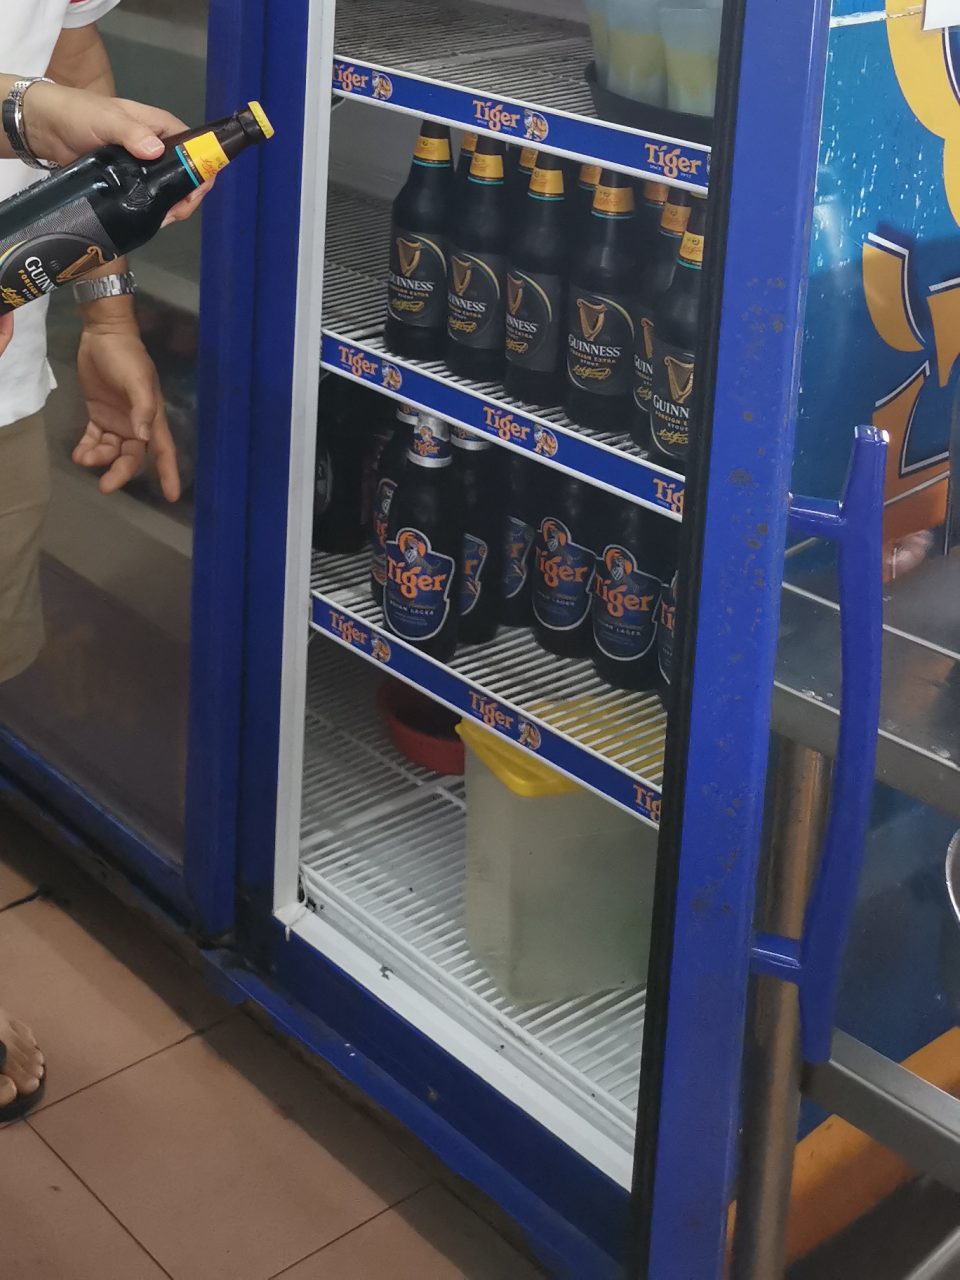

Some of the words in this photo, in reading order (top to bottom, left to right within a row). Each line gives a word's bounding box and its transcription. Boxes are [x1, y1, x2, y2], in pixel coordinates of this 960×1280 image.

[472, 99, 520, 131] Tiger
[644, 142, 701, 178] Tiger
[25, 256, 58, 293] GUINN
[339, 345, 379, 376] Tiger
[568, 333, 622, 358] GUINNESS
[634, 354, 653, 375] GUIN
[483, 406, 530, 441] Tiger
[653, 394, 690, 418] GUINN
[653, 478, 685, 515] Tig
[387, 555, 447, 599] Tiger
[596, 572, 655, 618] Tiger
[329, 610, 368, 644] Tiger
[469, 690, 514, 729] Tiger
[633, 783, 662, 822] Tig
